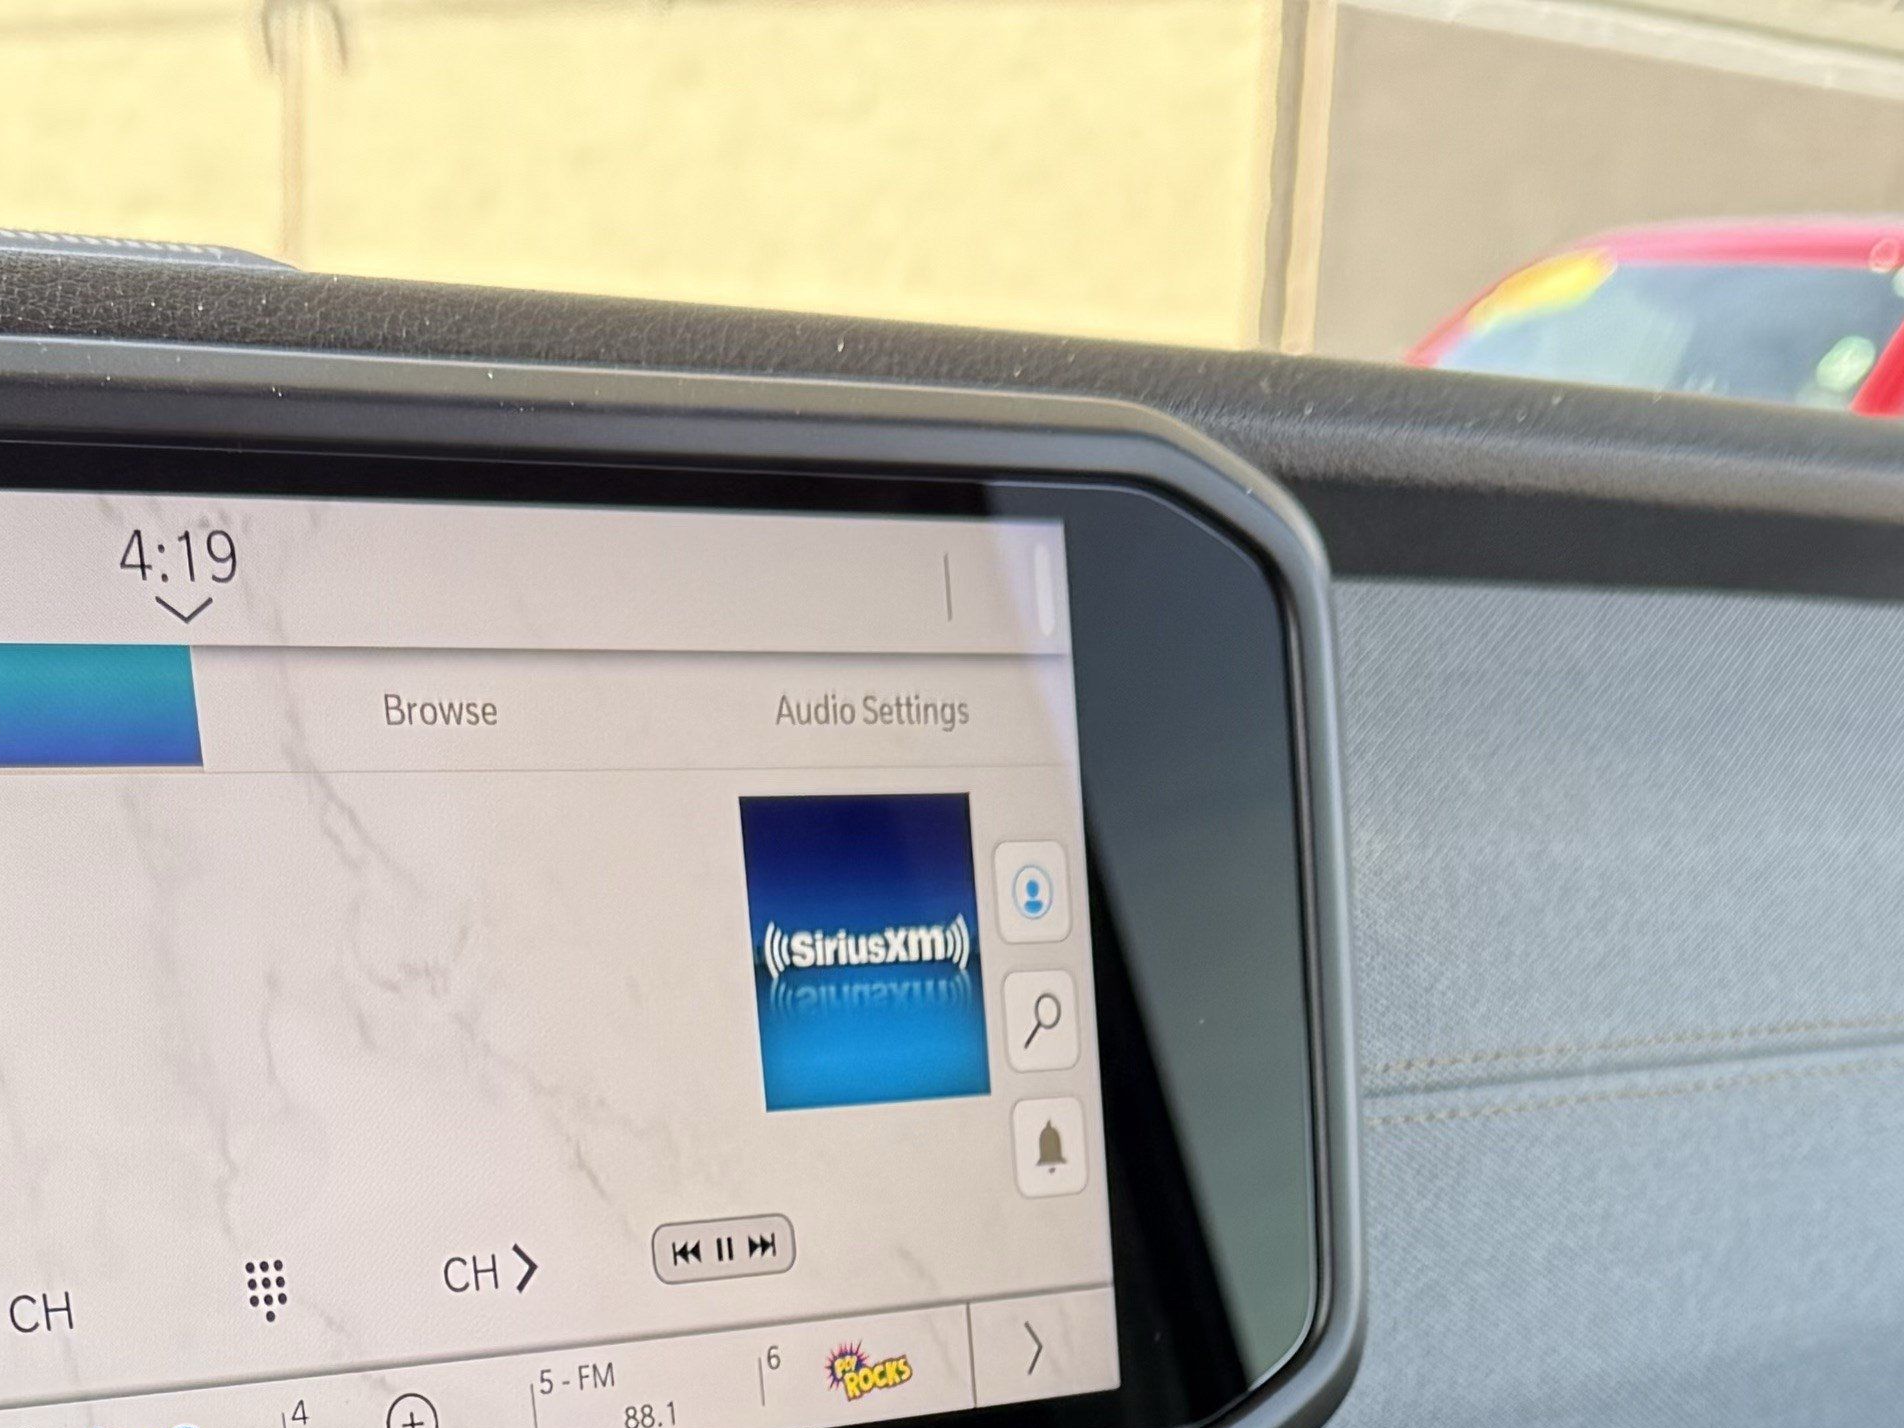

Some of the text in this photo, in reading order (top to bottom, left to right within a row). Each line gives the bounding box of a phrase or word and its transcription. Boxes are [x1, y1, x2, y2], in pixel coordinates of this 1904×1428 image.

[118, 527, 239, 586] 4:19
[384, 692, 497, 728] Browse
[775, 692, 970, 733] Audio Settings
[443, 1253, 498, 1293] CH
[8, 1291, 75, 1333] CH
[578, 1362, 616, 1391] FM
[767, 1346, 781, 1372] 6
[844, 1358, 911, 1397] ROCKS
[290, 1401, 310, 1427] 4
